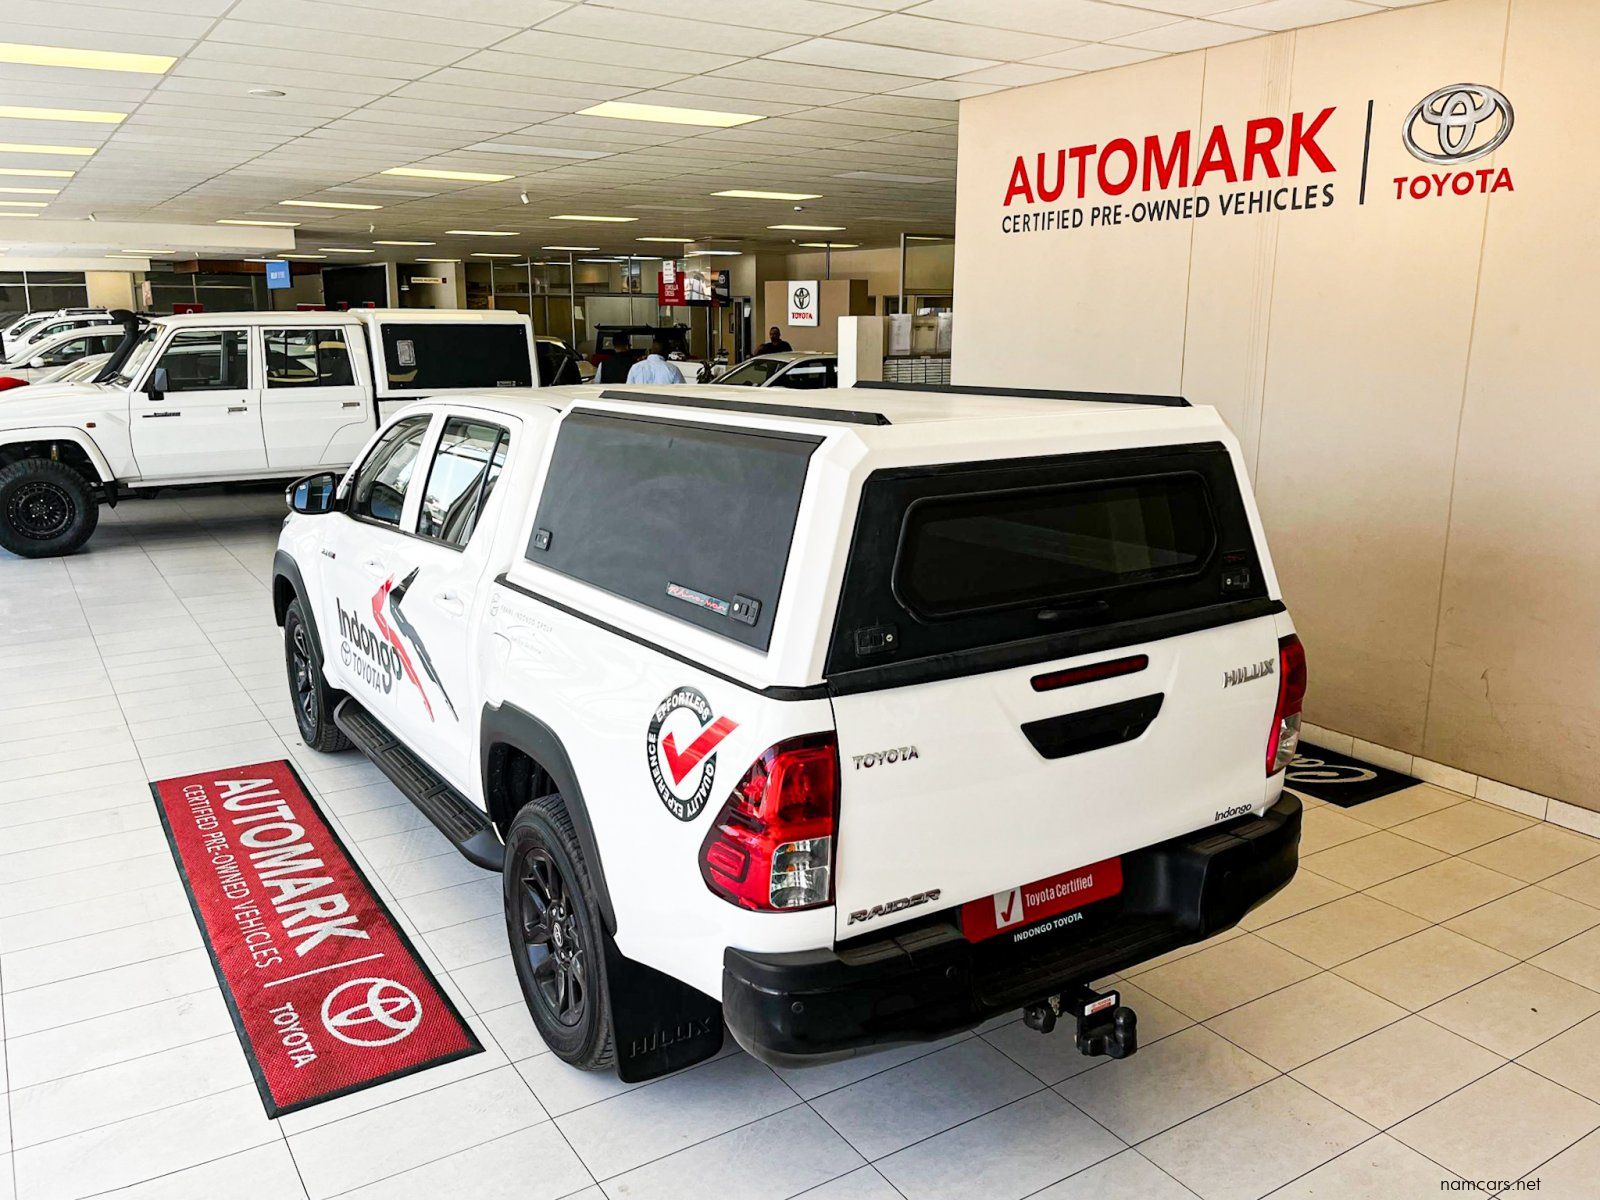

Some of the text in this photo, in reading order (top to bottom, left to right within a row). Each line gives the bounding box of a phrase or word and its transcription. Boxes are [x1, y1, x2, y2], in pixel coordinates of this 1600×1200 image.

[1003, 106, 1337, 207] AUTOMARK
[1393, 166, 1515, 200] TOYOTA
[1001, 182, 1335, 234] CERTIFIED PRE-OWNED VEHICLES
[792, 312, 813, 320] TOYOTA
[336, 596, 402, 695] Indongo
[353, 651, 381, 694] TOYOTA
[1222, 658, 1275, 689] HILUX
[648, 691, 715, 818] EFFORTLESS QUALITY EXPERIENCE
[852, 745, 919, 771] TOYOTA
[1214, 803, 1252, 822] Indongo
[182, 783, 284, 970] CERTIFIED PRE-OWNED VEHICLES
[214, 778, 371, 958] AUTOMARK
[847, 888, 941, 926] RAIDER
[1025, 873, 1094, 908] Toyota Certified
[1013, 912, 1084, 943] INDONGO TOYOTA
[268, 1001, 318, 1069] TOYOTA
